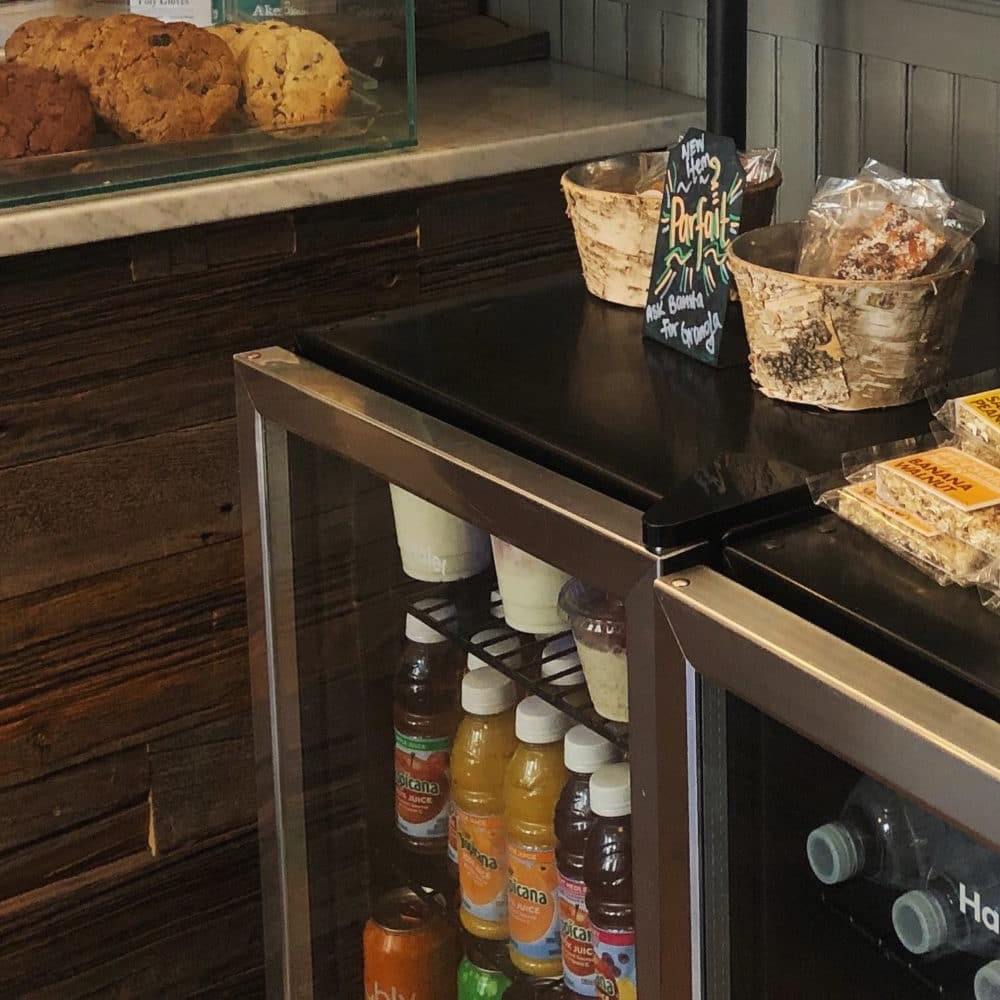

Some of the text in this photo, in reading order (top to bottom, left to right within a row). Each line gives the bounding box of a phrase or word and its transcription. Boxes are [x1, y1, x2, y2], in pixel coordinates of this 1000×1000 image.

[681, 132, 705, 160] NEW
[669, 191, 730, 272] Parfait
[893, 461, 960, 493] WALNUT
[908, 457, 973, 492] BANANA
[397, 772, 439, 795] picana
[574, 945, 594, 956] JUIC
